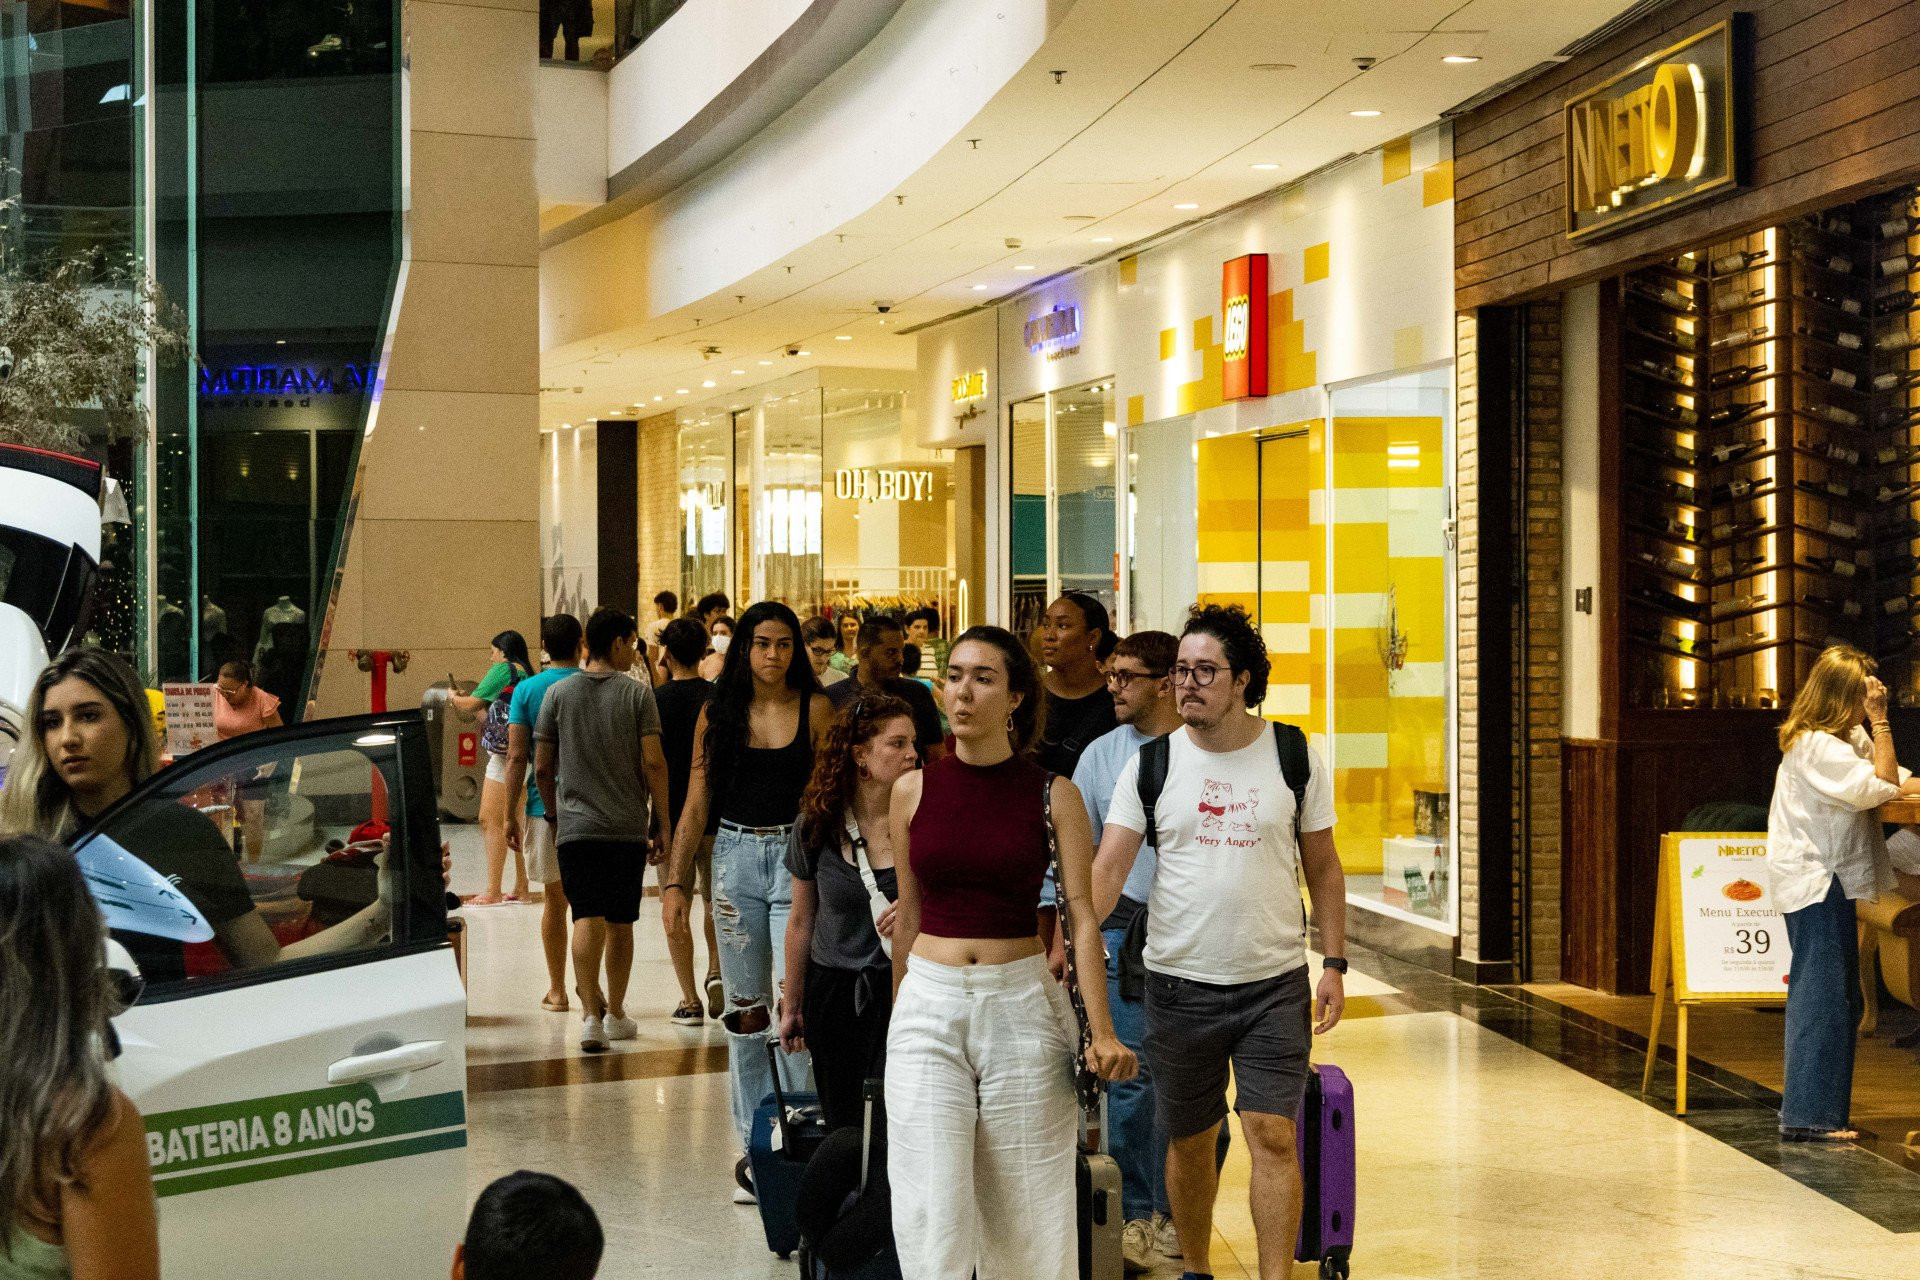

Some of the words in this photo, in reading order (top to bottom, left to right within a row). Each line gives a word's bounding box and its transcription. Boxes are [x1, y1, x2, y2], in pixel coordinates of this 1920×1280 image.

[1225, 301, 1248, 356] LEGO
[878, 469, 933, 502] BOY!
[1717, 845, 1767, 857] NINETTO
[1699, 907, 1732, 917] Menu
[1736, 930, 1770, 954] 39
[145, 1115, 271, 1167] BATERIA
[273, 1111, 293, 1147] 8
[298, 1098, 375, 1143] ANOS
